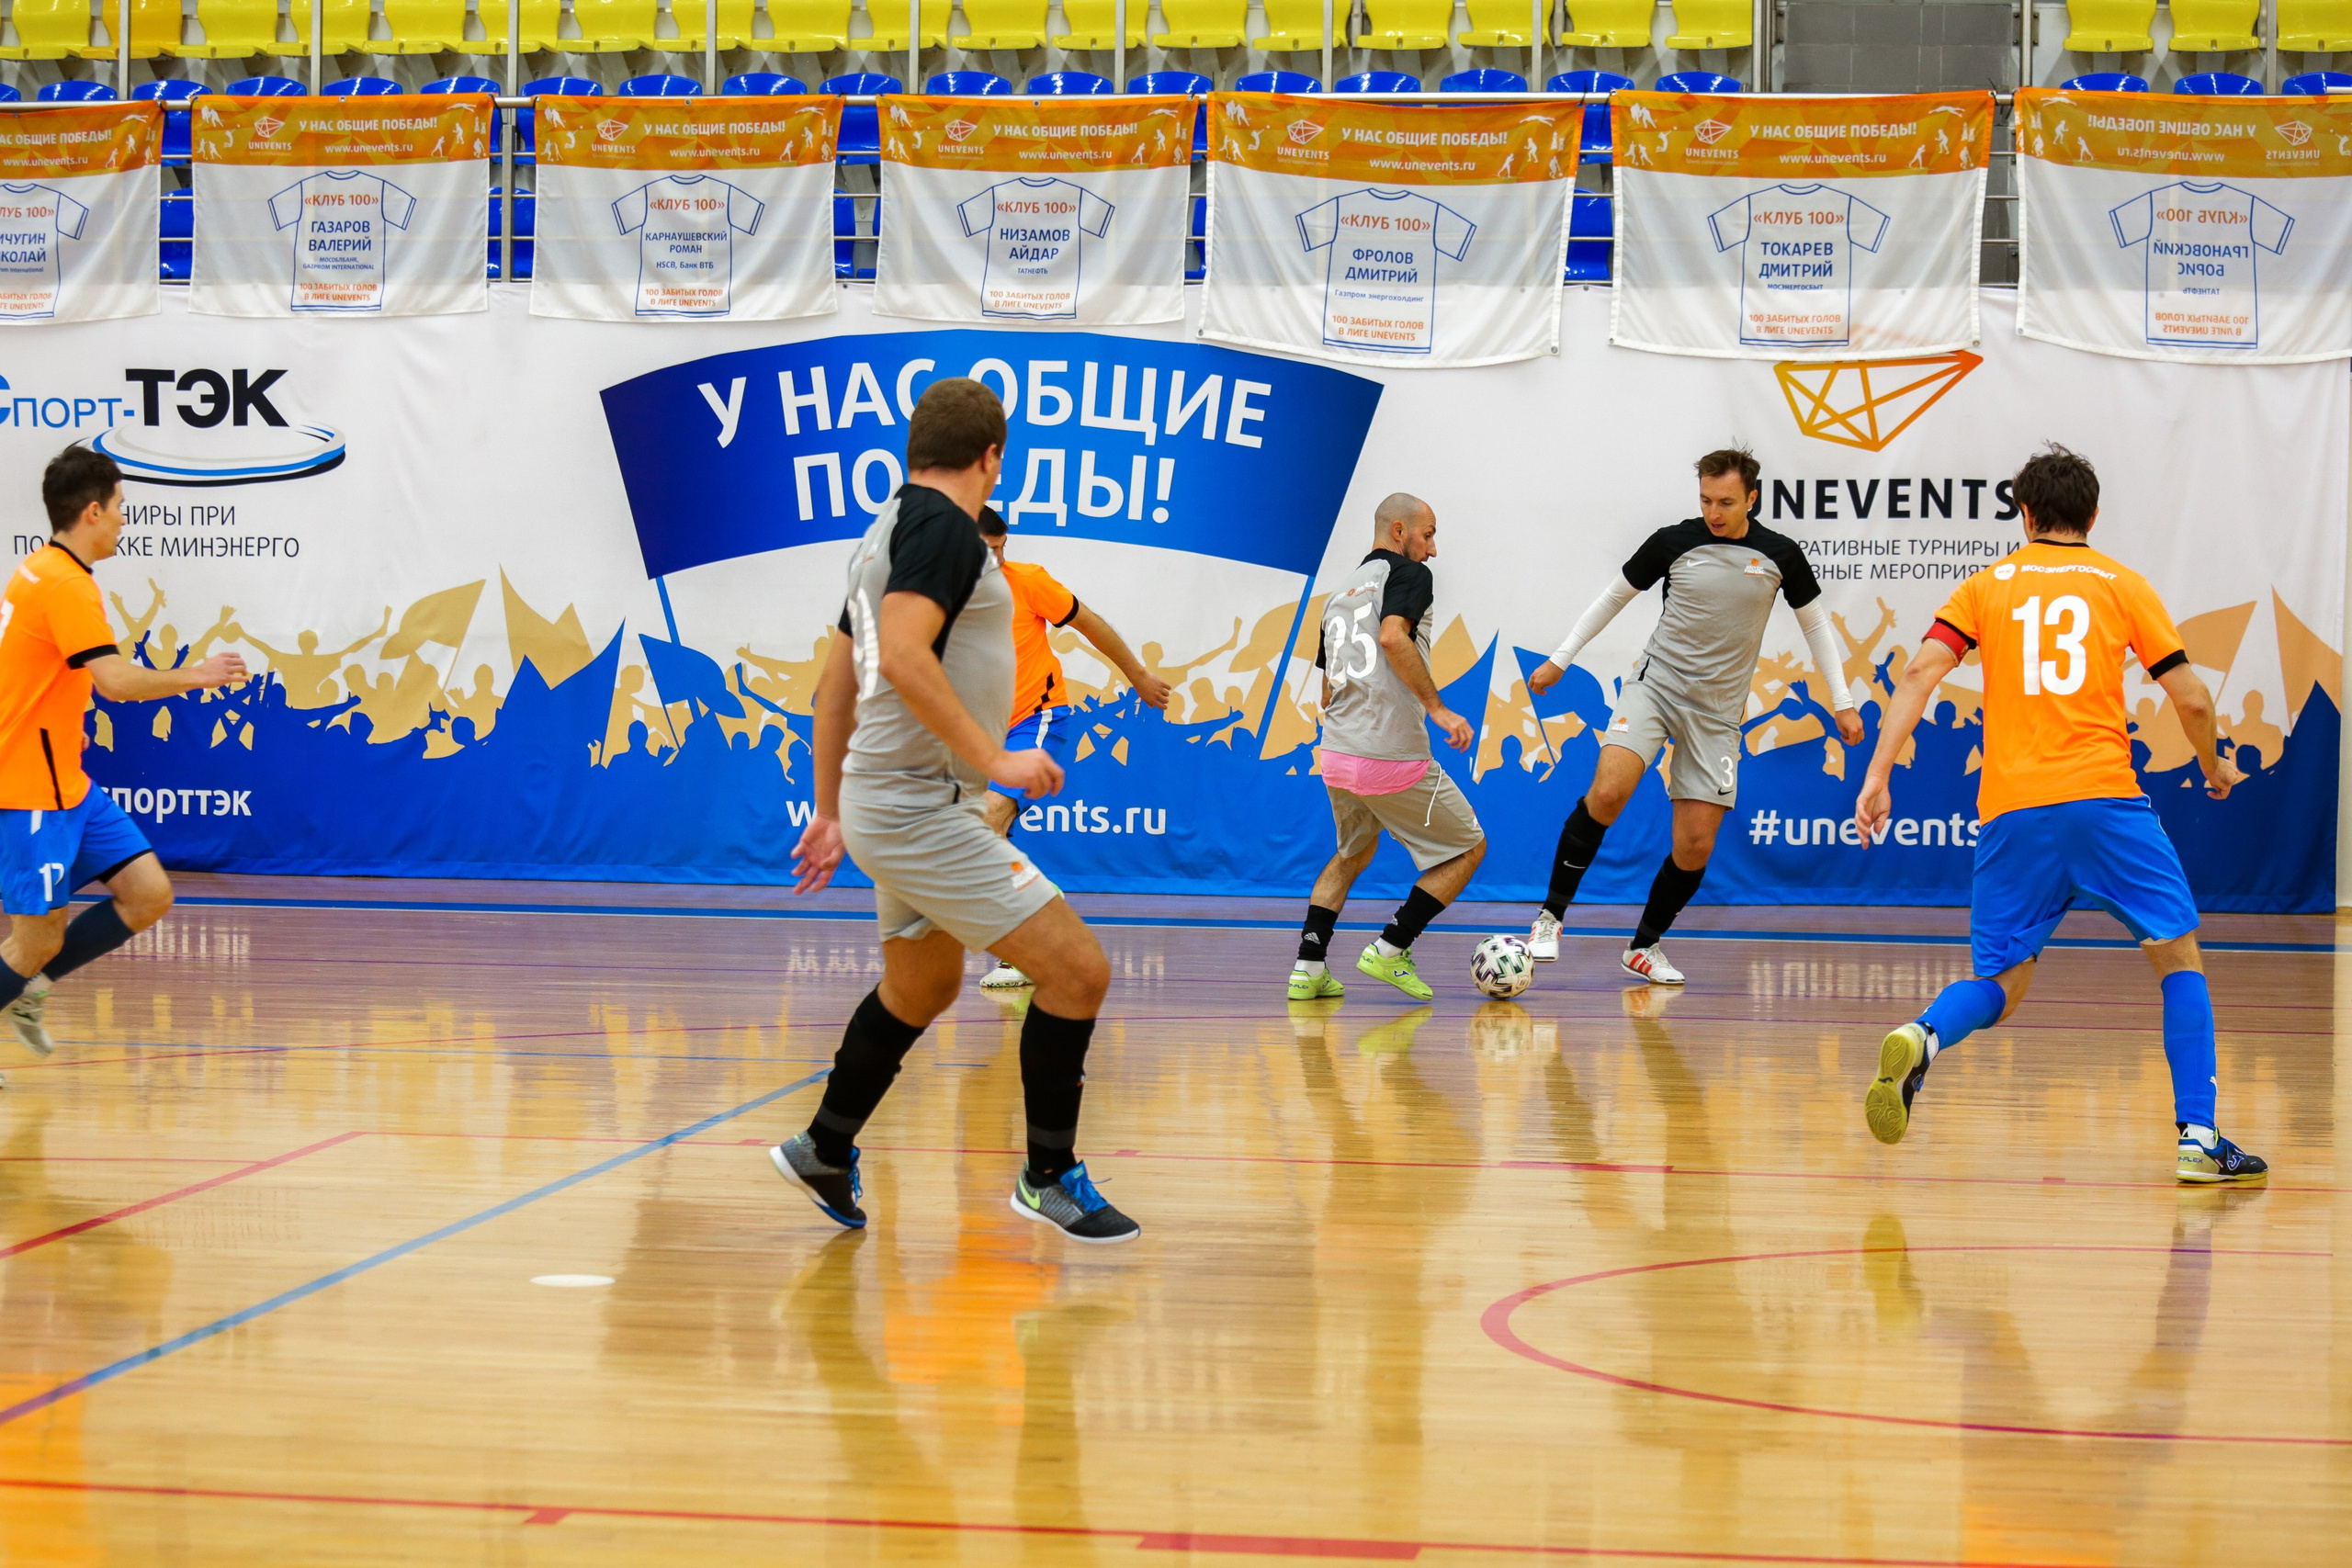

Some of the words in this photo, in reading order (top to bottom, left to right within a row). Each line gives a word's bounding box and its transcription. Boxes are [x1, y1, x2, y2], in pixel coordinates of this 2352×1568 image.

[300, 120, 308, 131] У
[311, 120, 333, 131] НАС
[337, 119, 379, 132] ОБЩИЕ
[382, 118, 437, 130] ПОБЕДЫ!
[644, 123, 652, 135] У
[655, 123, 679, 135] НАС
[682, 122, 726, 136] ОБЩИЕ
[729, 120, 786, 134] ПОБЕДЫ!
[993, 125, 1002, 136] У
[1004, 125, 1029, 137] НАС
[1032, 125, 1077, 139] ОБЩИЕ
[1080, 123, 1137, 137] ПОБЕДЫ!
[1749, 125, 1759, 138] У
[1762, 125, 1791, 139] НАС
[1794, 125, 1847, 140] ОБЩИЕ
[1850, 122, 1917, 138] ПОБЕДЫ!
[16, 134, 56, 146] ОБЩИЕ
[60, 130, 112, 143] ПОБЕДЫ!
[1341, 128, 1351, 140] У
[1354, 129, 1383, 143] НАС
[1385, 131, 1438, 148] ОБЩИЕ
[1442, 131, 1508, 147] ПОБЕДЫ!
[248, 141, 292, 151] UNEVENTS
[325, 143, 413, 153] www.unevents.ru
[591, 143, 636, 153] UNEVENTS
[670, 147, 761, 158] www.unevents.ru
[938, 144, 984, 154] UNEVENTS
[1277, 146, 1330, 160] UNEVENTS
[3, 155, 88, 166] www.unevents.ru
[1019, 150, 1113, 160] www.unevents.ru
[1686, 148, 1739, 159] UNEVENTS
[1780, 152, 1886, 164] www.unevents.ru
[1369, 159, 1476, 171] www.unevents.ru
[305, 194, 345, 206] «КЛУБ
[350, 194, 379, 206] 100»
[650, 198, 690, 210] «КЛУБ
[695, 198, 725, 210] 100»
[26, 207, 54, 218] 100»
[997, 201, 1040, 214] «КЛУБ
[1046, 202, 1077, 214] 100»
[1340, 214, 1390, 230] «КЛУБ
[1395, 218, 1430, 231] 100»
[1753, 211, 1804, 225] «КЛУБ
[1808, 211, 1845, 225] 100»
[311, 220, 370, 233] ГАЗАРОВ
[645, 231, 728, 241] КАРНАУШЕВСКИЙ
[1000, 228, 1070, 242] НИЗАМОВ
[309, 236, 371, 251] ВАЛЕРИЙ
[669, 245, 702, 254] РОМАН
[1760, 242, 1833, 256] ТОКАРЕВ
[1009, 245, 1059, 262] АЙДАР
[1352, 248, 1414, 264] ФРОЛОВ
[1345, 266, 1418, 283] ДМИТРИЙ
[1758, 260, 1833, 279] ДМИТРИЙ
[1335, 289, 1366, 299] Газпром
[1368, 293, 1424, 302] энергохолдинг
[1332, 315, 1348, 324] 100
[1351, 317, 1393, 328] ЗАБИТЫХ
[1395, 321, 1424, 330] ГОЛОВ
[1749, 314, 1764, 322] 100
[1767, 314, 1809, 323] ЗАБИТЫХ
[1812, 314, 1841, 322] ГОЛОВ
[1347, 329, 1368, 338] ЛИГЕ
[1371, 331, 1416, 341] UNEVENTS
[1764, 326, 1785, 334] ЛИГЕ
[1788, 326, 1833, 334] UNEVENTS
[697, 377, 746, 448] У
[778, 358, 935, 436] НАС
[794, 448, 1176, 526] ПОДЫ!
[122, 505, 182, 526] НИРЫ
[190, 505, 236, 526] ПРИ
[161, 536, 300, 558] МИНЭНЕРГО
[1798, 540, 1901, 557] РАТИВНЫЕ
[1907, 539, 1999, 557] ТУРНИРЫ
[1870, 563, 1991, 580] МЕРОПРИЯ
[2012, 594, 2090, 695] 13
[1721, 756, 1734, 788] 3
[99, 787, 252, 824] порттэк
